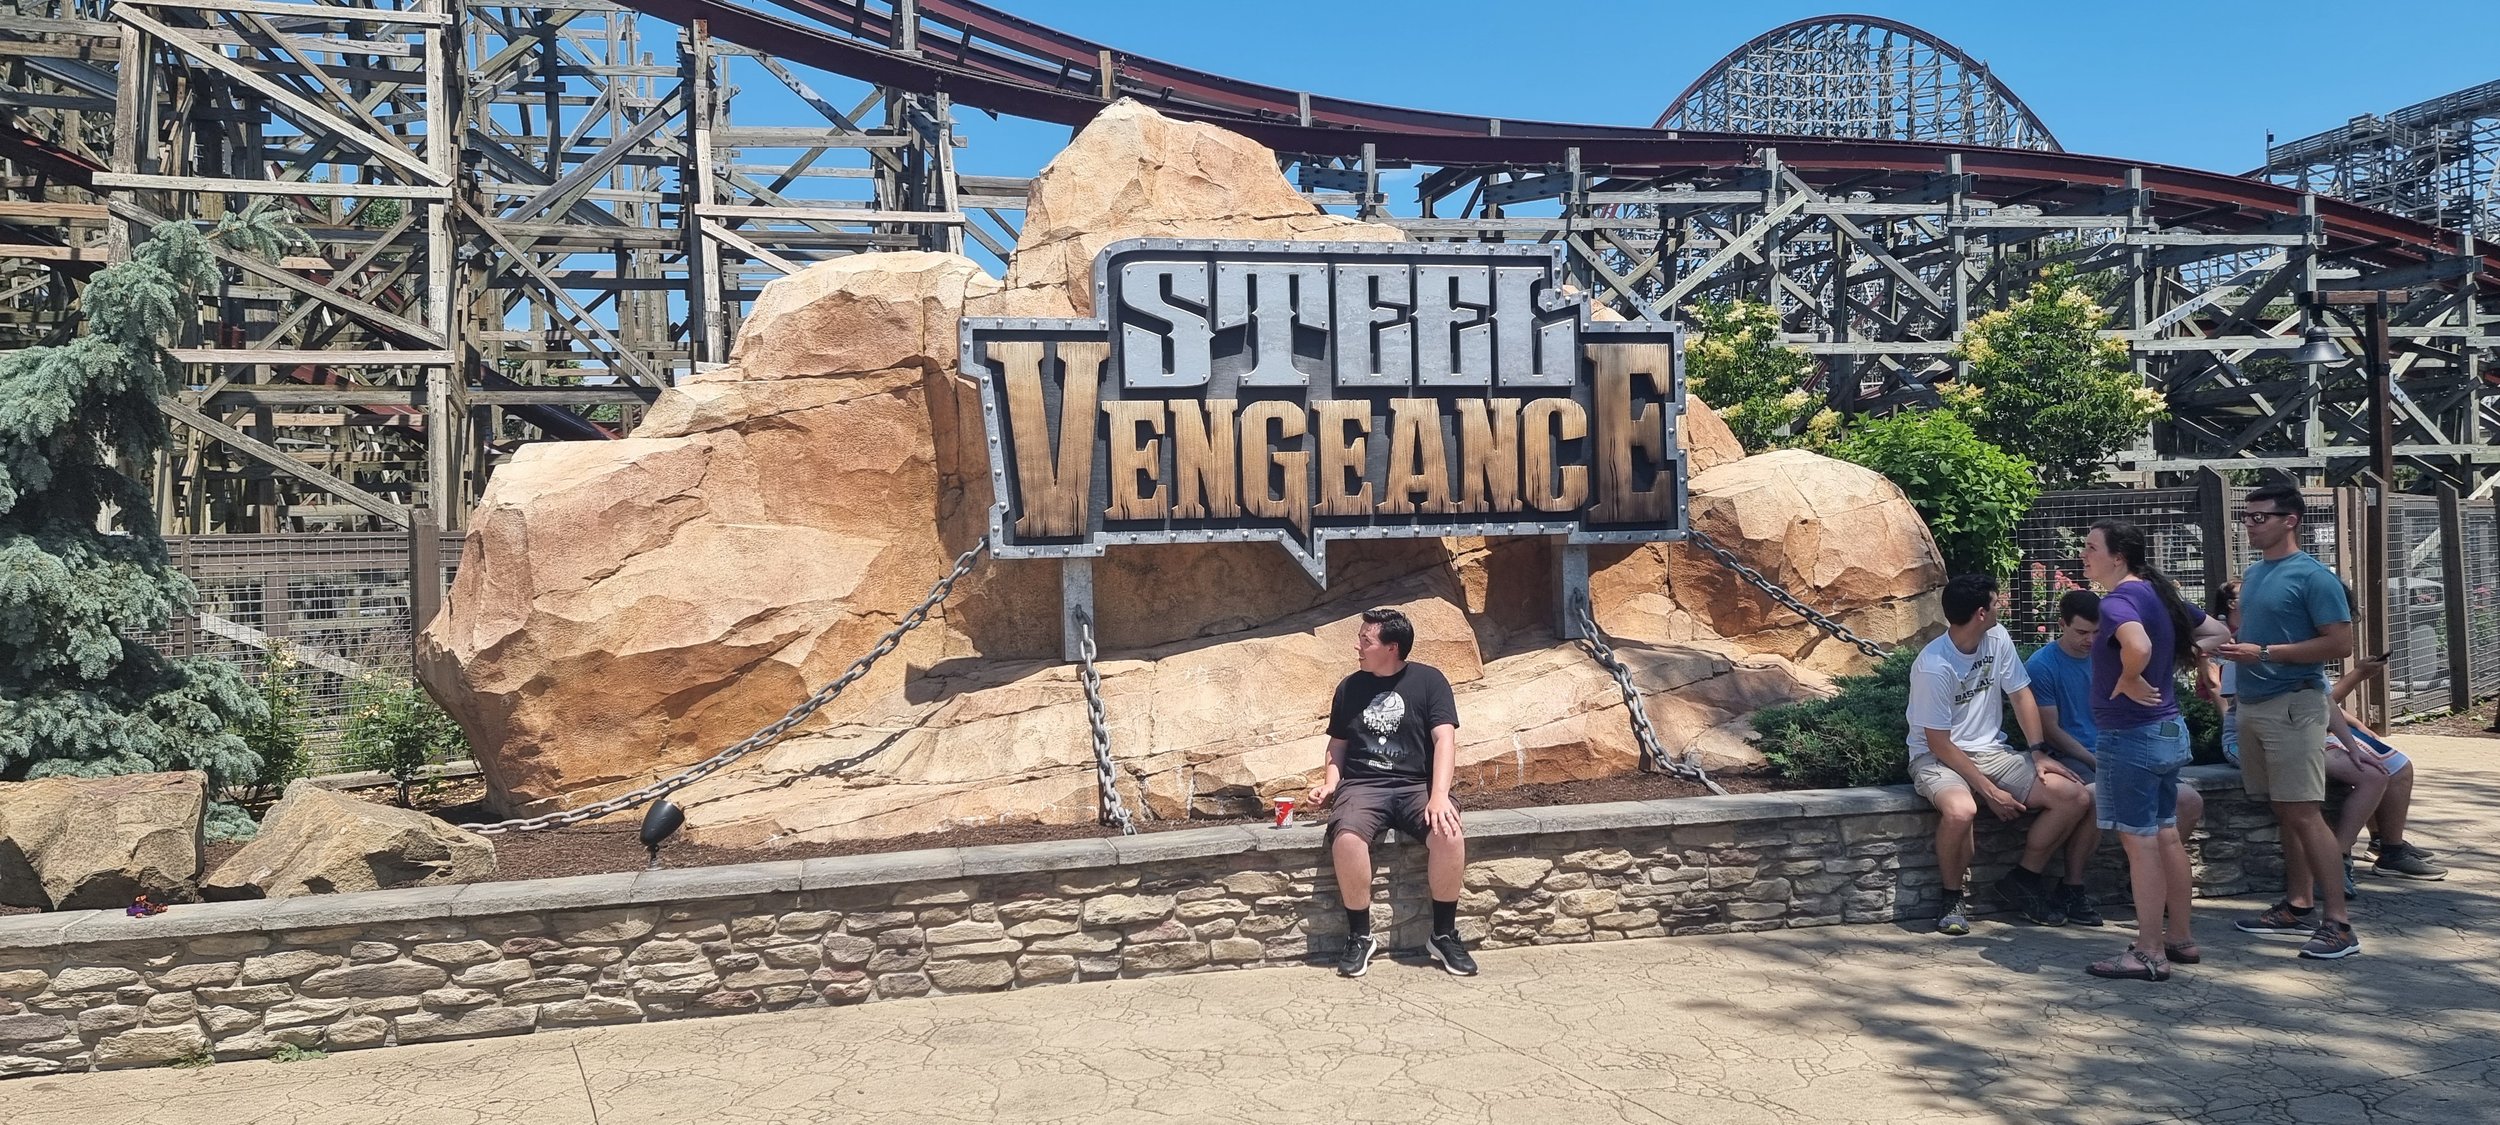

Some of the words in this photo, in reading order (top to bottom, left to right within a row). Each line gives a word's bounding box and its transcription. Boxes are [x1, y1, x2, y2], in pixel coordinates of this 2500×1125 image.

[1120, 261, 1576, 388] STEEL
[985, 341, 1670, 542] VENGEANCE
[1955, 678, 1995, 702] BASAL
